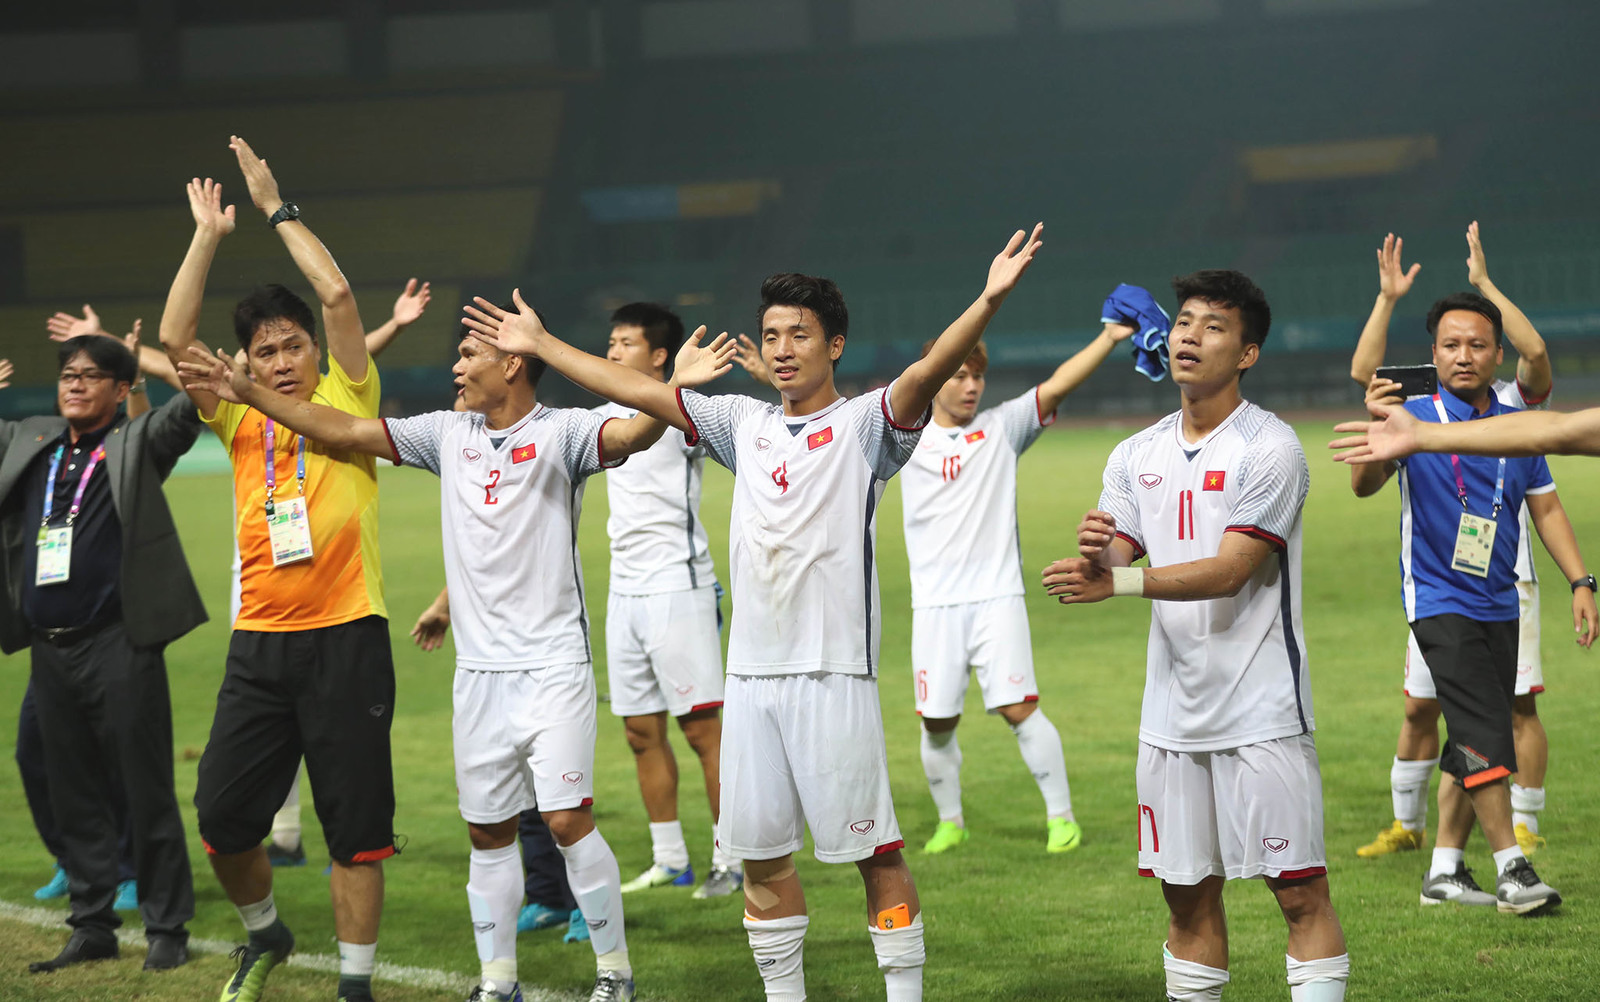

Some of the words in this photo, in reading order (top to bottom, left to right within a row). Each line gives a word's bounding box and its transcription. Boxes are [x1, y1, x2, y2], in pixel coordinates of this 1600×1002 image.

[771, 460, 789, 495] 4
[942, 454, 961, 483] 16
[484, 469, 501, 505] 2
[1137, 803, 1160, 853] 17
